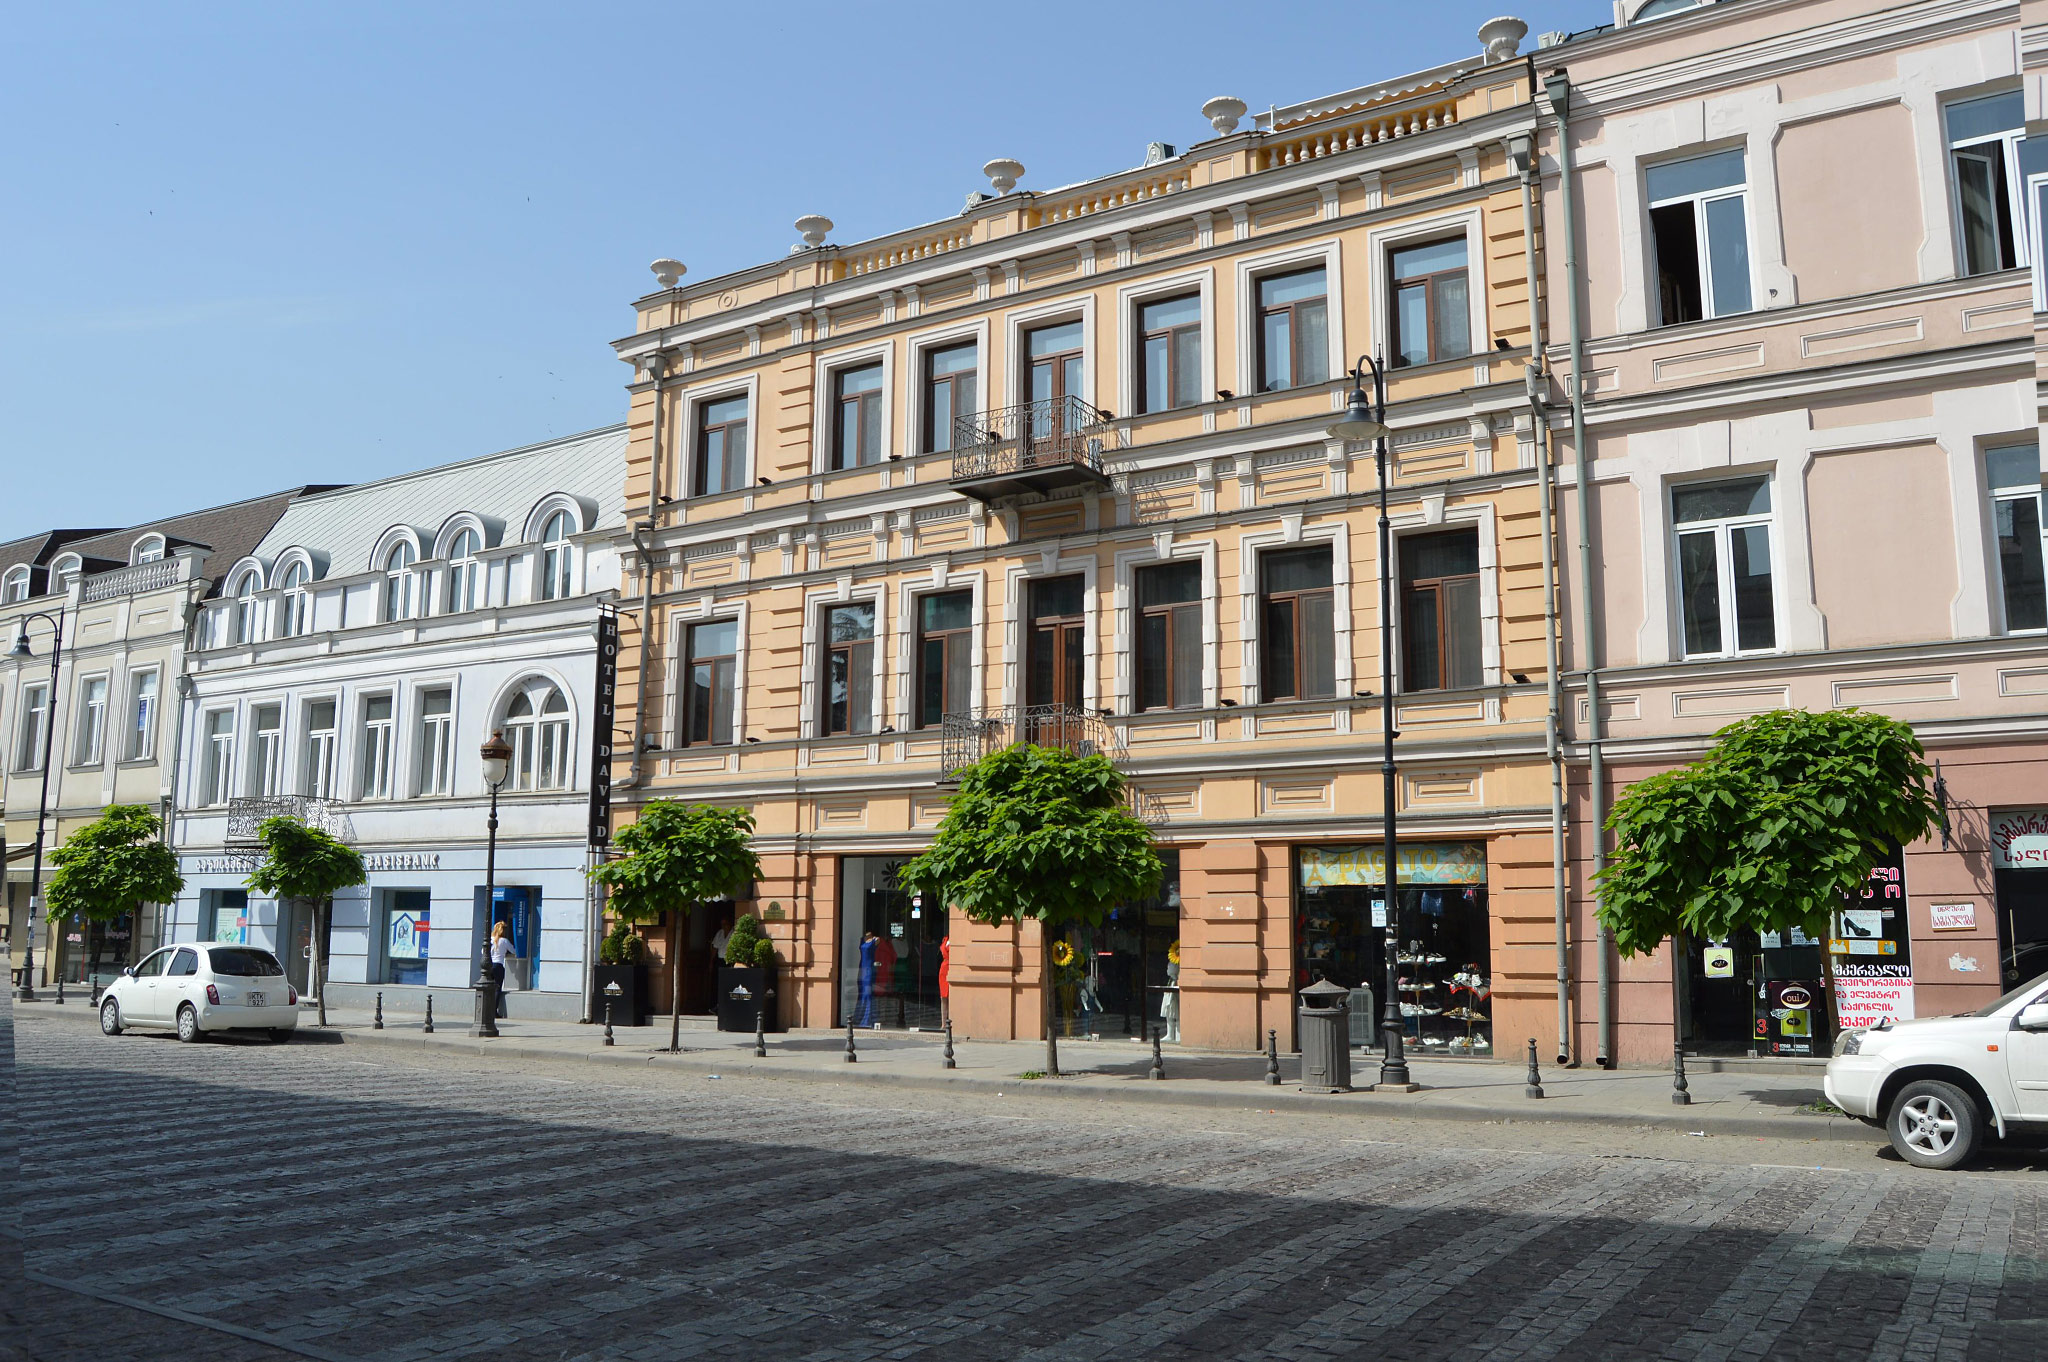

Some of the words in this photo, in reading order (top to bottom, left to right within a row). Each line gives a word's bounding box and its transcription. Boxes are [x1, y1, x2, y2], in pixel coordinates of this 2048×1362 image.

[603, 623, 616, 716] HOTEL
[597, 745, 610, 837] DAVID
[367, 853, 439, 868] BASISBANK
[1850, 990, 1900, 999] ელექტრო
[1841, 1003, 1894, 1012] საქონლის
